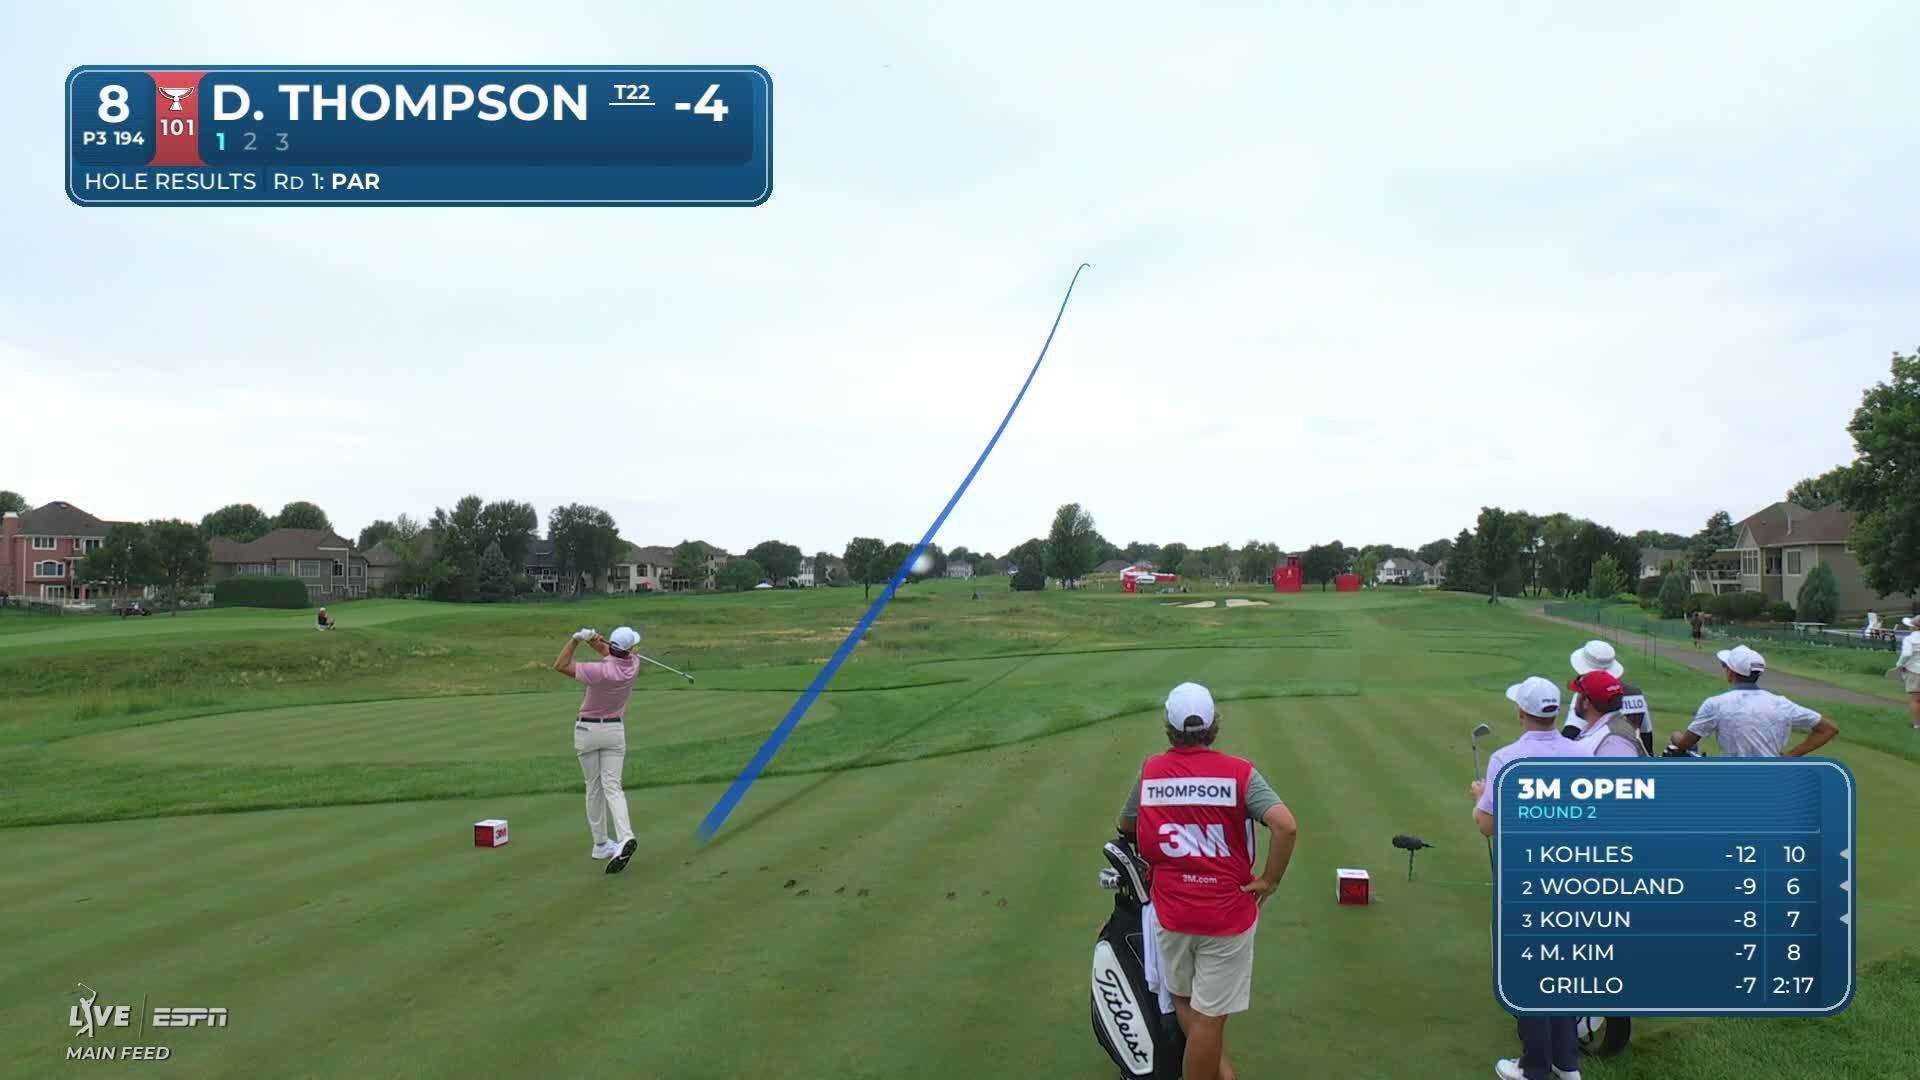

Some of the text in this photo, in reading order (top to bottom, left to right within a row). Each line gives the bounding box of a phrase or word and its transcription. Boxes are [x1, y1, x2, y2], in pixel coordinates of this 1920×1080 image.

[1146, 784, 1233, 799] THOMPSON
[495, 827, 508, 839] 3M
[1158, 823, 1231, 858] 3M
[1182, 874, 1218, 884] 3M.com
[1095, 968, 1149, 1063] Titleist
